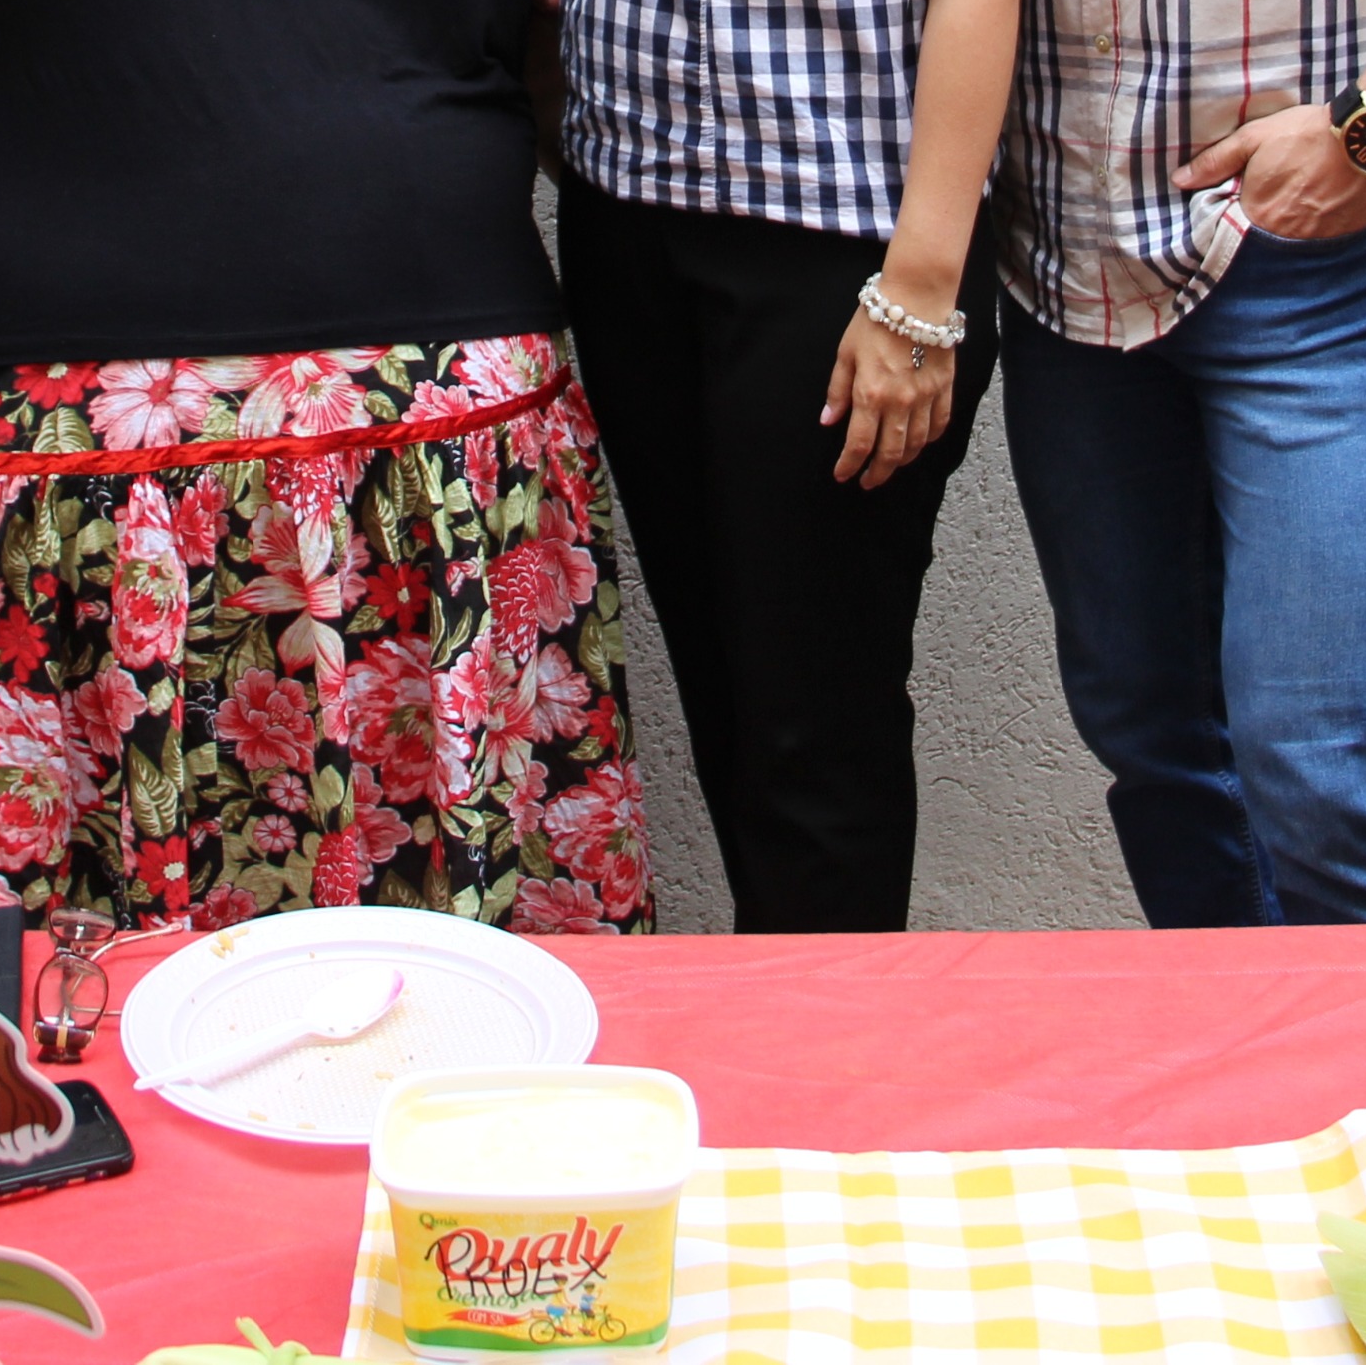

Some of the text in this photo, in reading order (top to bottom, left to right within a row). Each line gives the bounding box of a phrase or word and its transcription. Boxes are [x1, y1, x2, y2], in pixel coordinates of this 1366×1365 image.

[419, 1212, 458, 1231] Qmix
[425, 1233, 611, 1299] PROEX
[435, 1216, 624, 1283] Qualy
[467, 1310, 506, 1327] COM SAL
